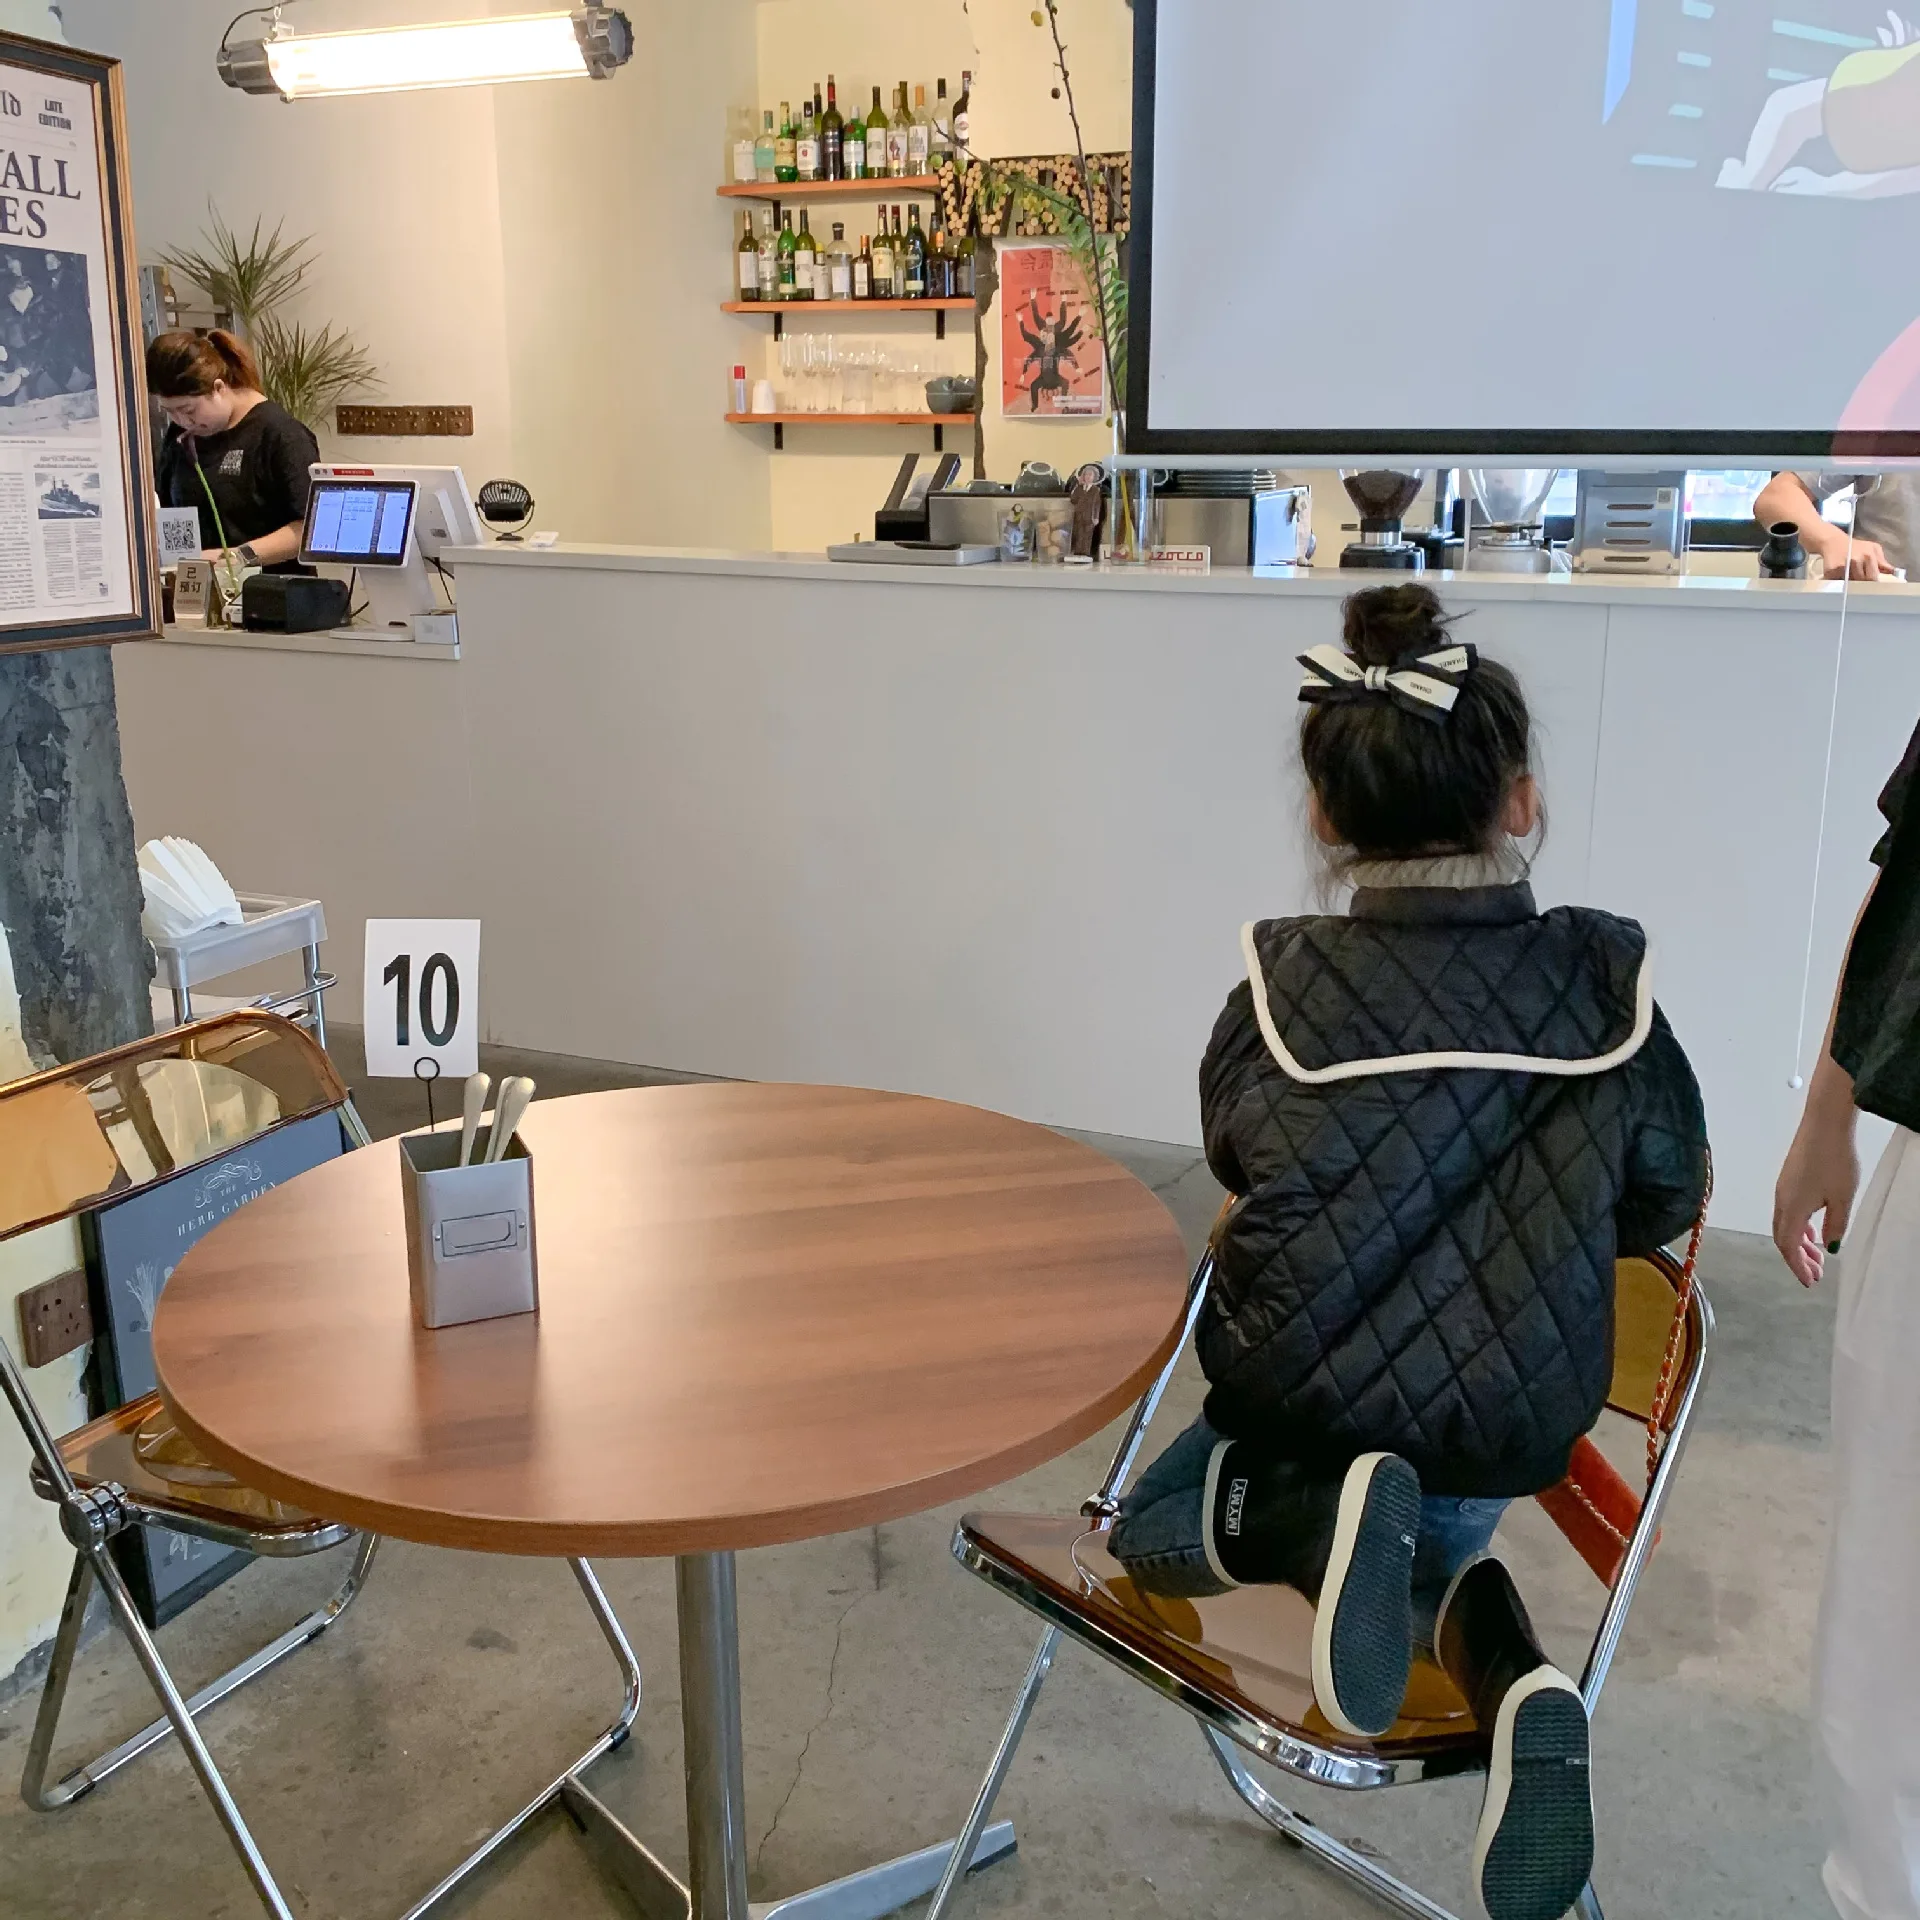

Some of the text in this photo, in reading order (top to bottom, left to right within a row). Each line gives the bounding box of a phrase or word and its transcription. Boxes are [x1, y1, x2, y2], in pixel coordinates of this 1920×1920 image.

[38, 113, 72, 131] EDITION
[0, 149, 81, 200] ALL
[179, 581, 201, 593] 预订
[384, 952, 460, 1047] 10
[220, 1184, 237, 1197] THE
[177, 1210, 215, 1237] HERB
[1228, 1482, 1243, 1529] MYMY
